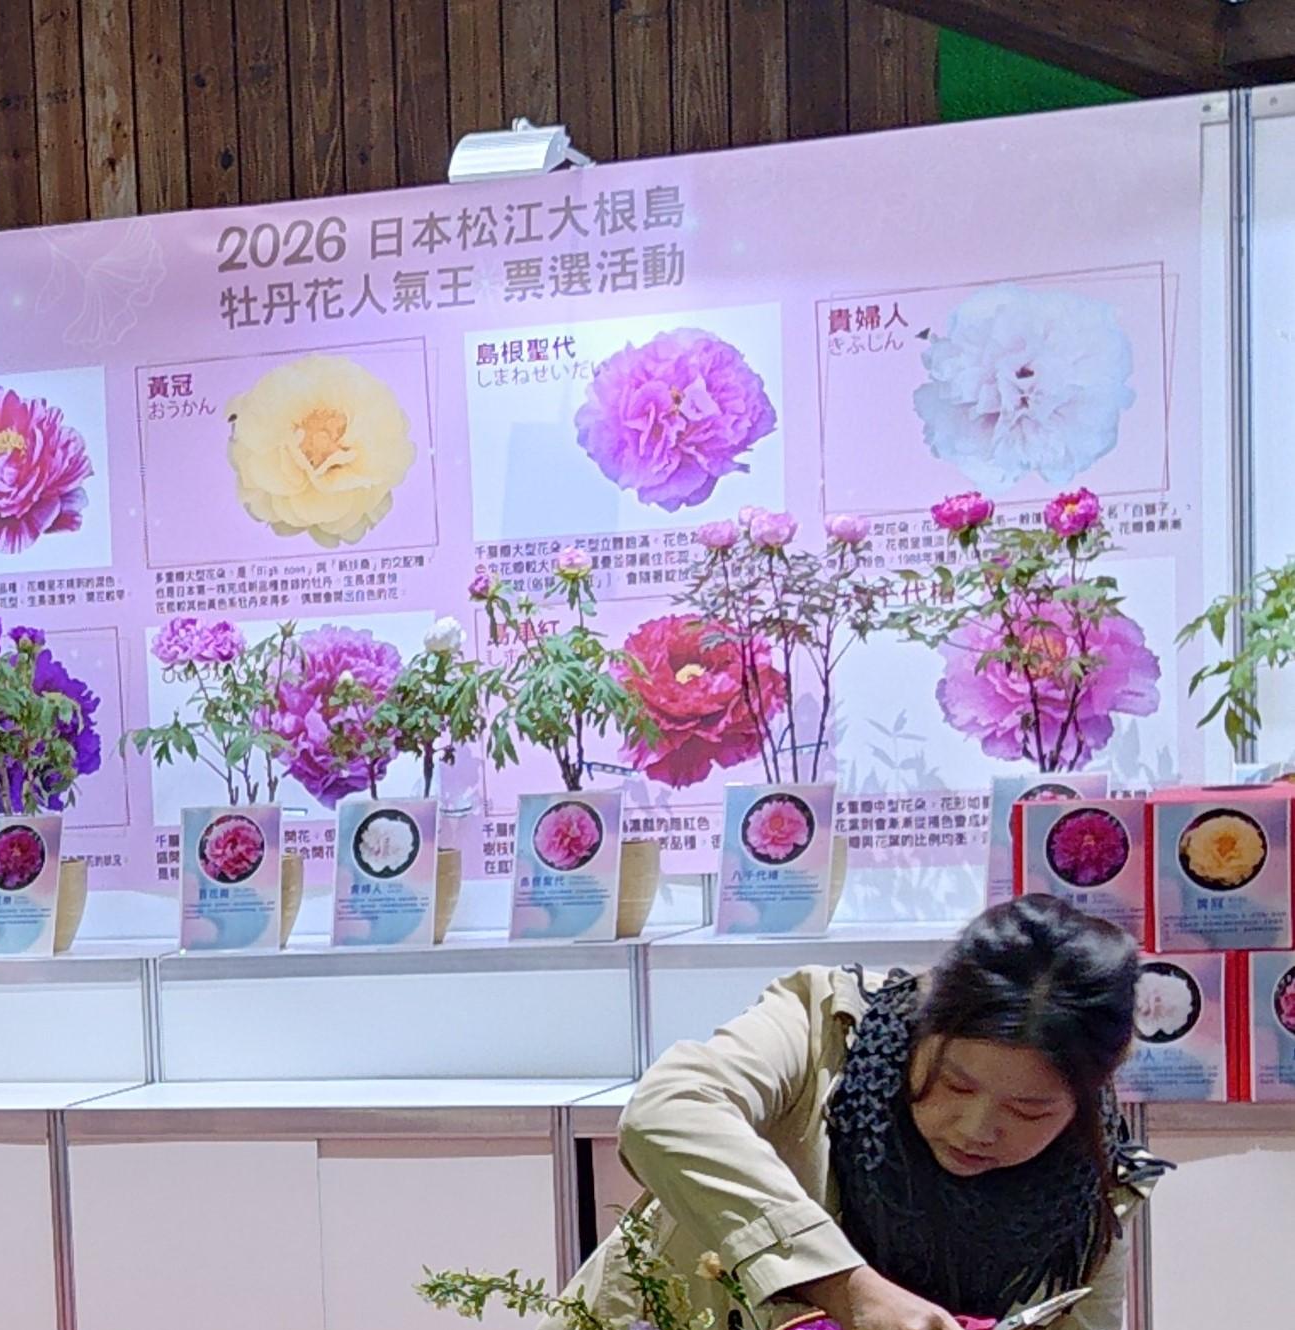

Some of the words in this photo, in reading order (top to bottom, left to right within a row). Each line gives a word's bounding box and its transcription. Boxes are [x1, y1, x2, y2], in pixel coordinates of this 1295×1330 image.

[217, 217, 347, 273] 2026
[370, 184, 686, 259] 日本松江大根島
[220, 265, 475, 329] 牡丹花人氣王
[503, 242, 686, 301] 票選活動
[828, 302, 909, 335] 貴婦人
[476, 336, 576, 366] 島根聖代
[148, 373, 193, 399] 黃冠
[148, 397, 217, 420] おうかん
